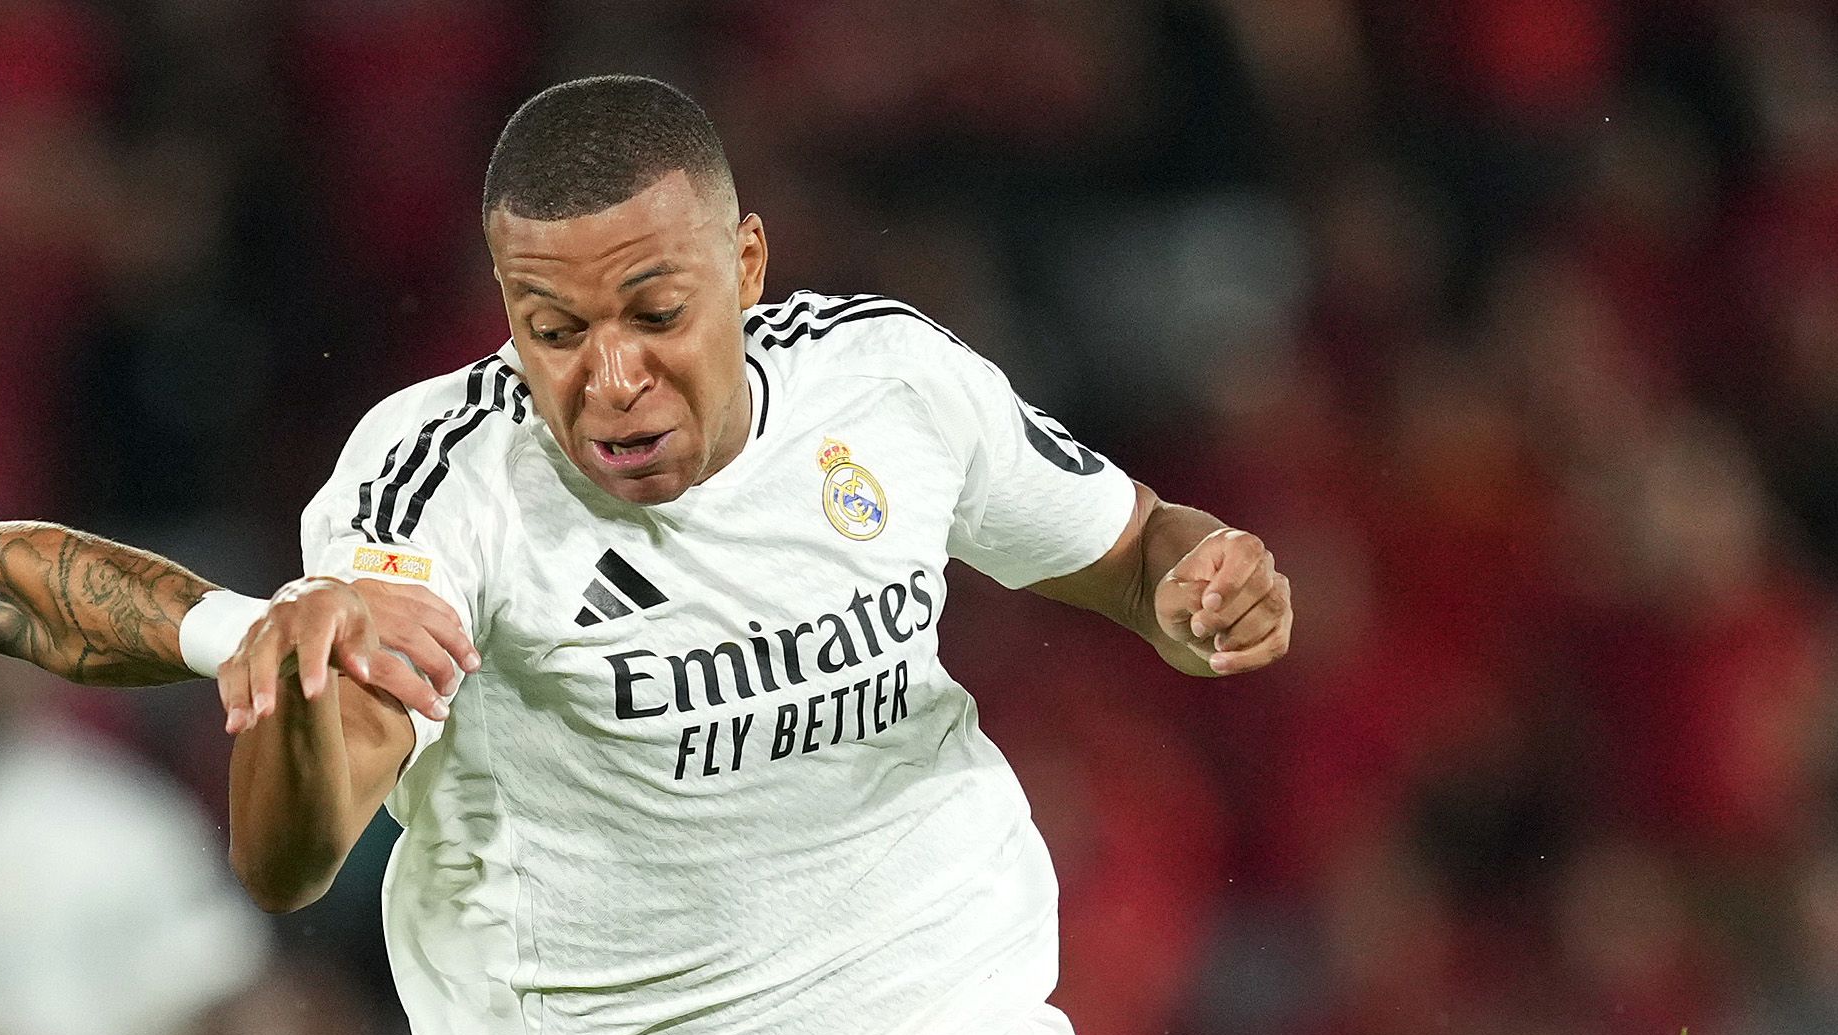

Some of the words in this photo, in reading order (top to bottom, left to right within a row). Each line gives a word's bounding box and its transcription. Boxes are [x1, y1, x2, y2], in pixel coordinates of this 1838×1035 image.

[603, 570, 933, 720] Emirates
[674, 713, 754, 780] FLY
[770, 660, 908, 761] BETTER
